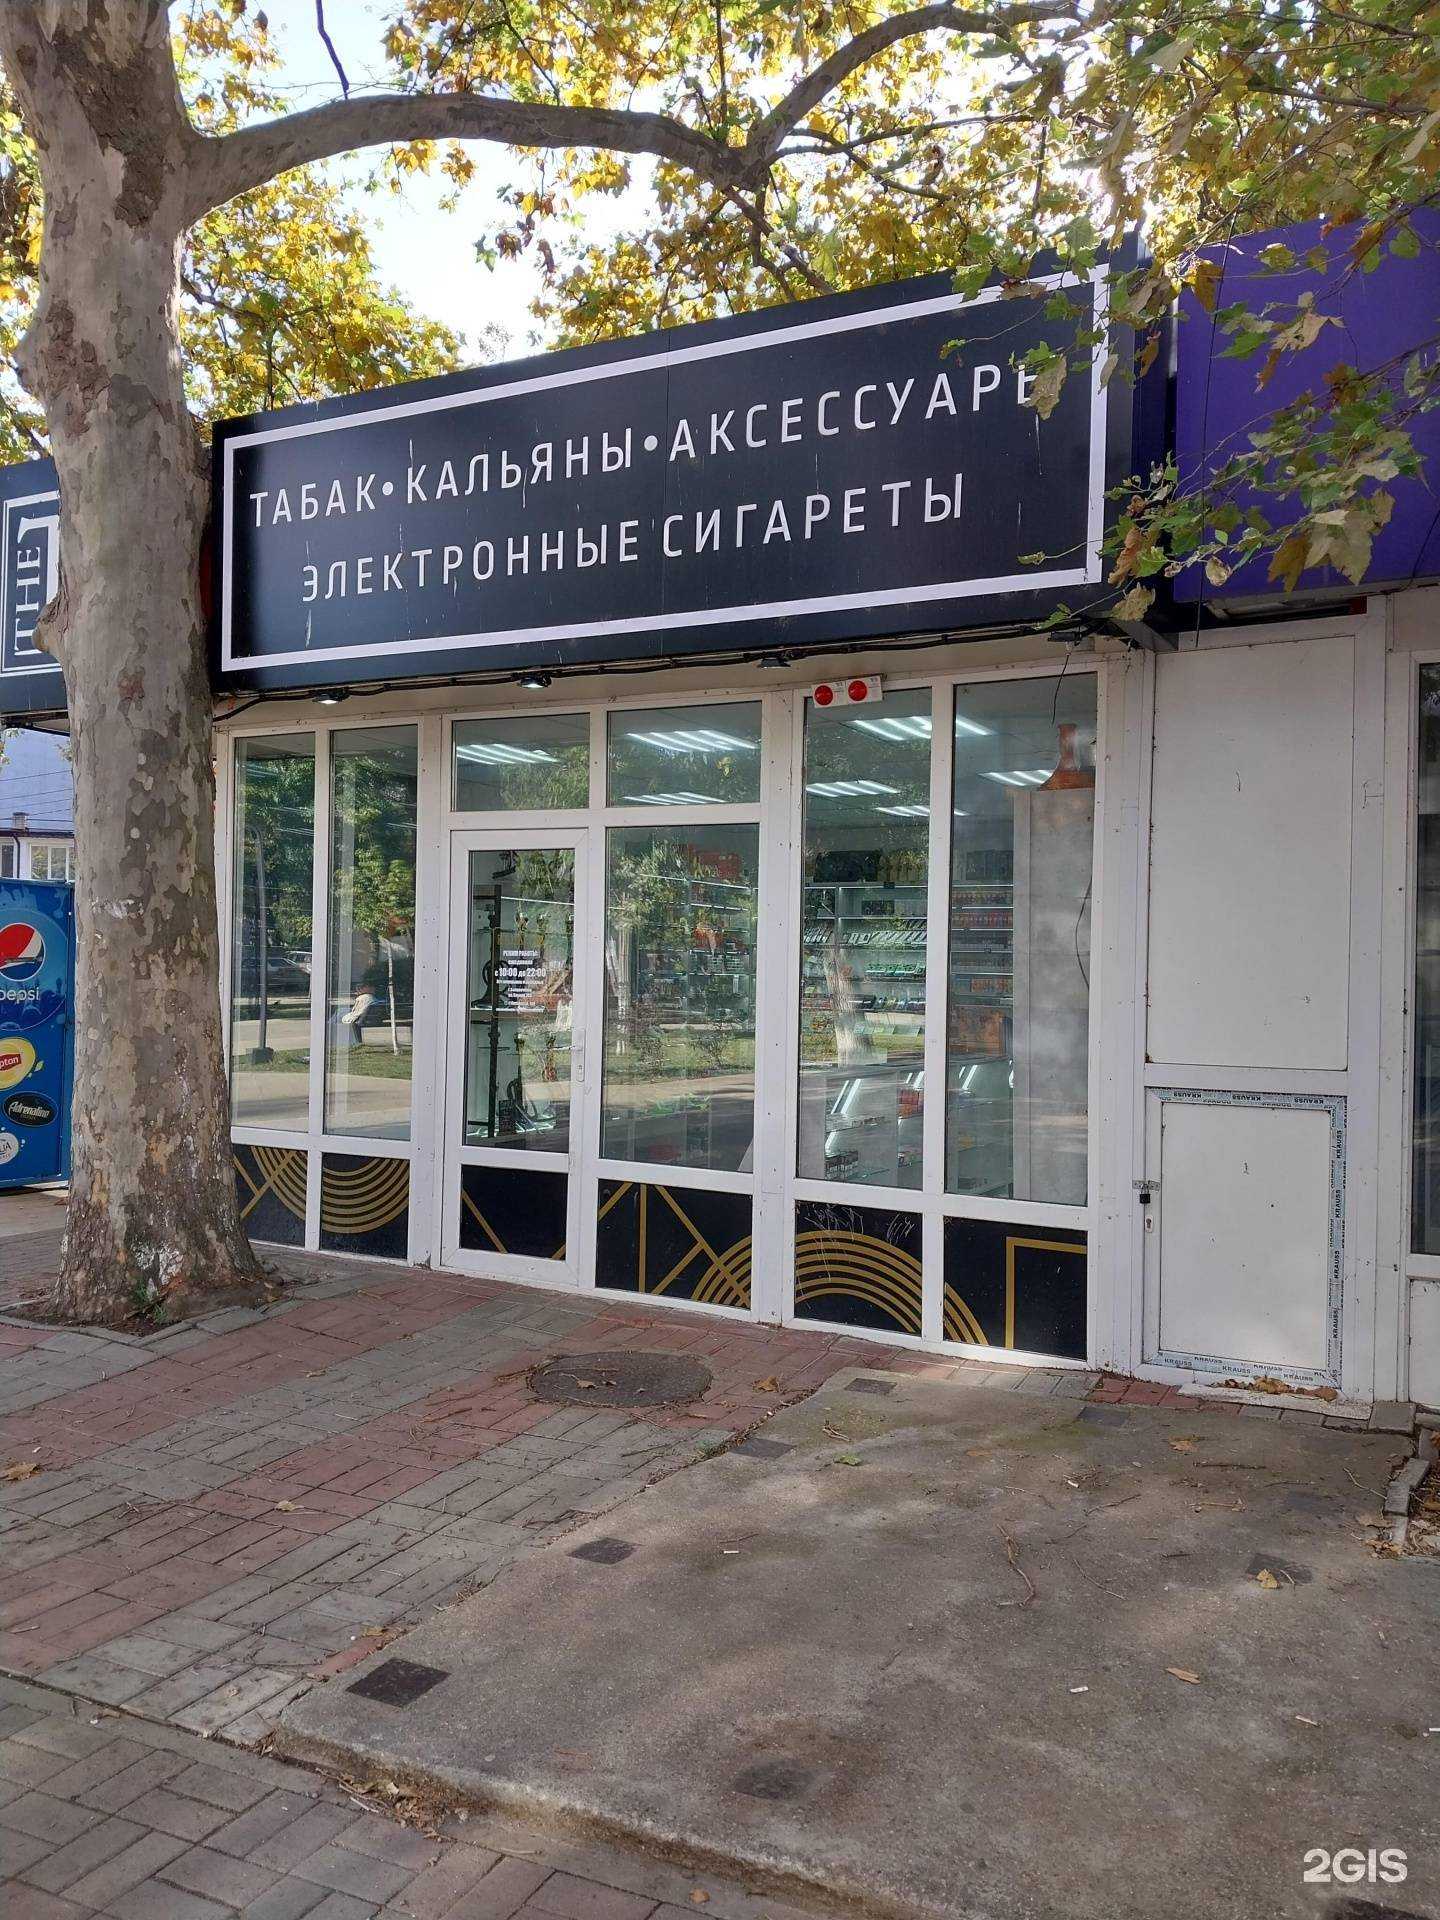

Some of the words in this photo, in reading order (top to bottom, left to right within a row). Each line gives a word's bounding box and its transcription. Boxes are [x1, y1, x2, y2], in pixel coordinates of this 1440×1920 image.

[250, 473, 376, 528] ТАБАК
[406, 427, 632, 504] КАЛЬЯНЫ
[301, 519, 640, 603] ЭЛЕКТРОННЫЕ
[662, 472, 964, 559] СИГАРЕТЫ
[1164, 1358, 1193, 1367] KRAUSS
[1222, 1366, 1251, 1374] KRAUSS
[1284, 1373, 1314, 1382] KRAUSS
